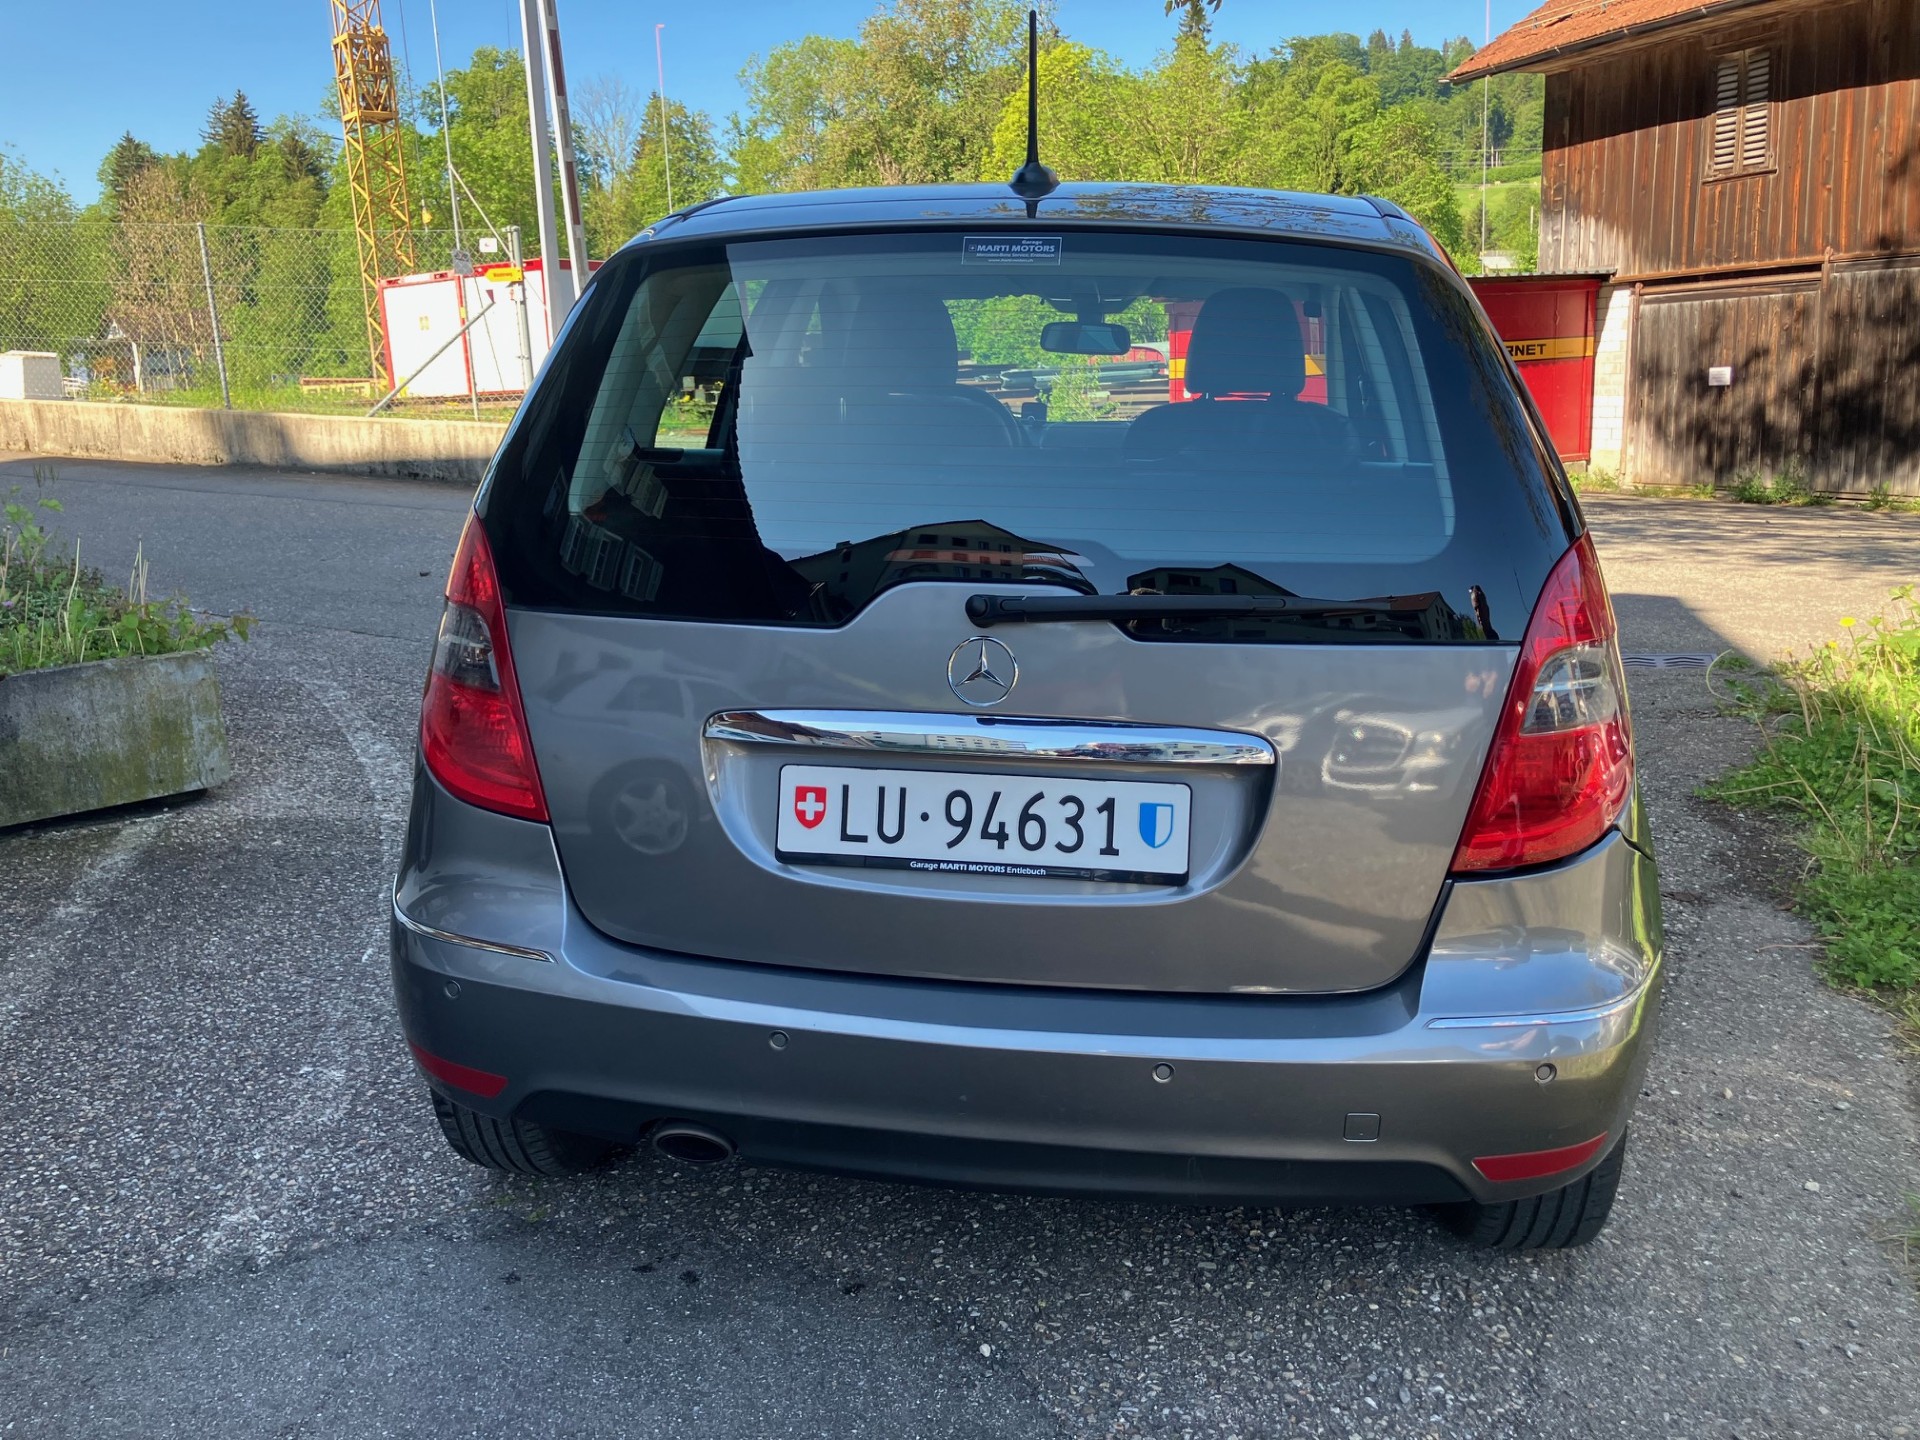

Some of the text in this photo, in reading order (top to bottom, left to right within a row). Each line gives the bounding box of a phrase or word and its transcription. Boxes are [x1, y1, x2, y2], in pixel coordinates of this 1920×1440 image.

[910, 861, 1047, 875] Garage MARTI MOTORS Entlebuch
